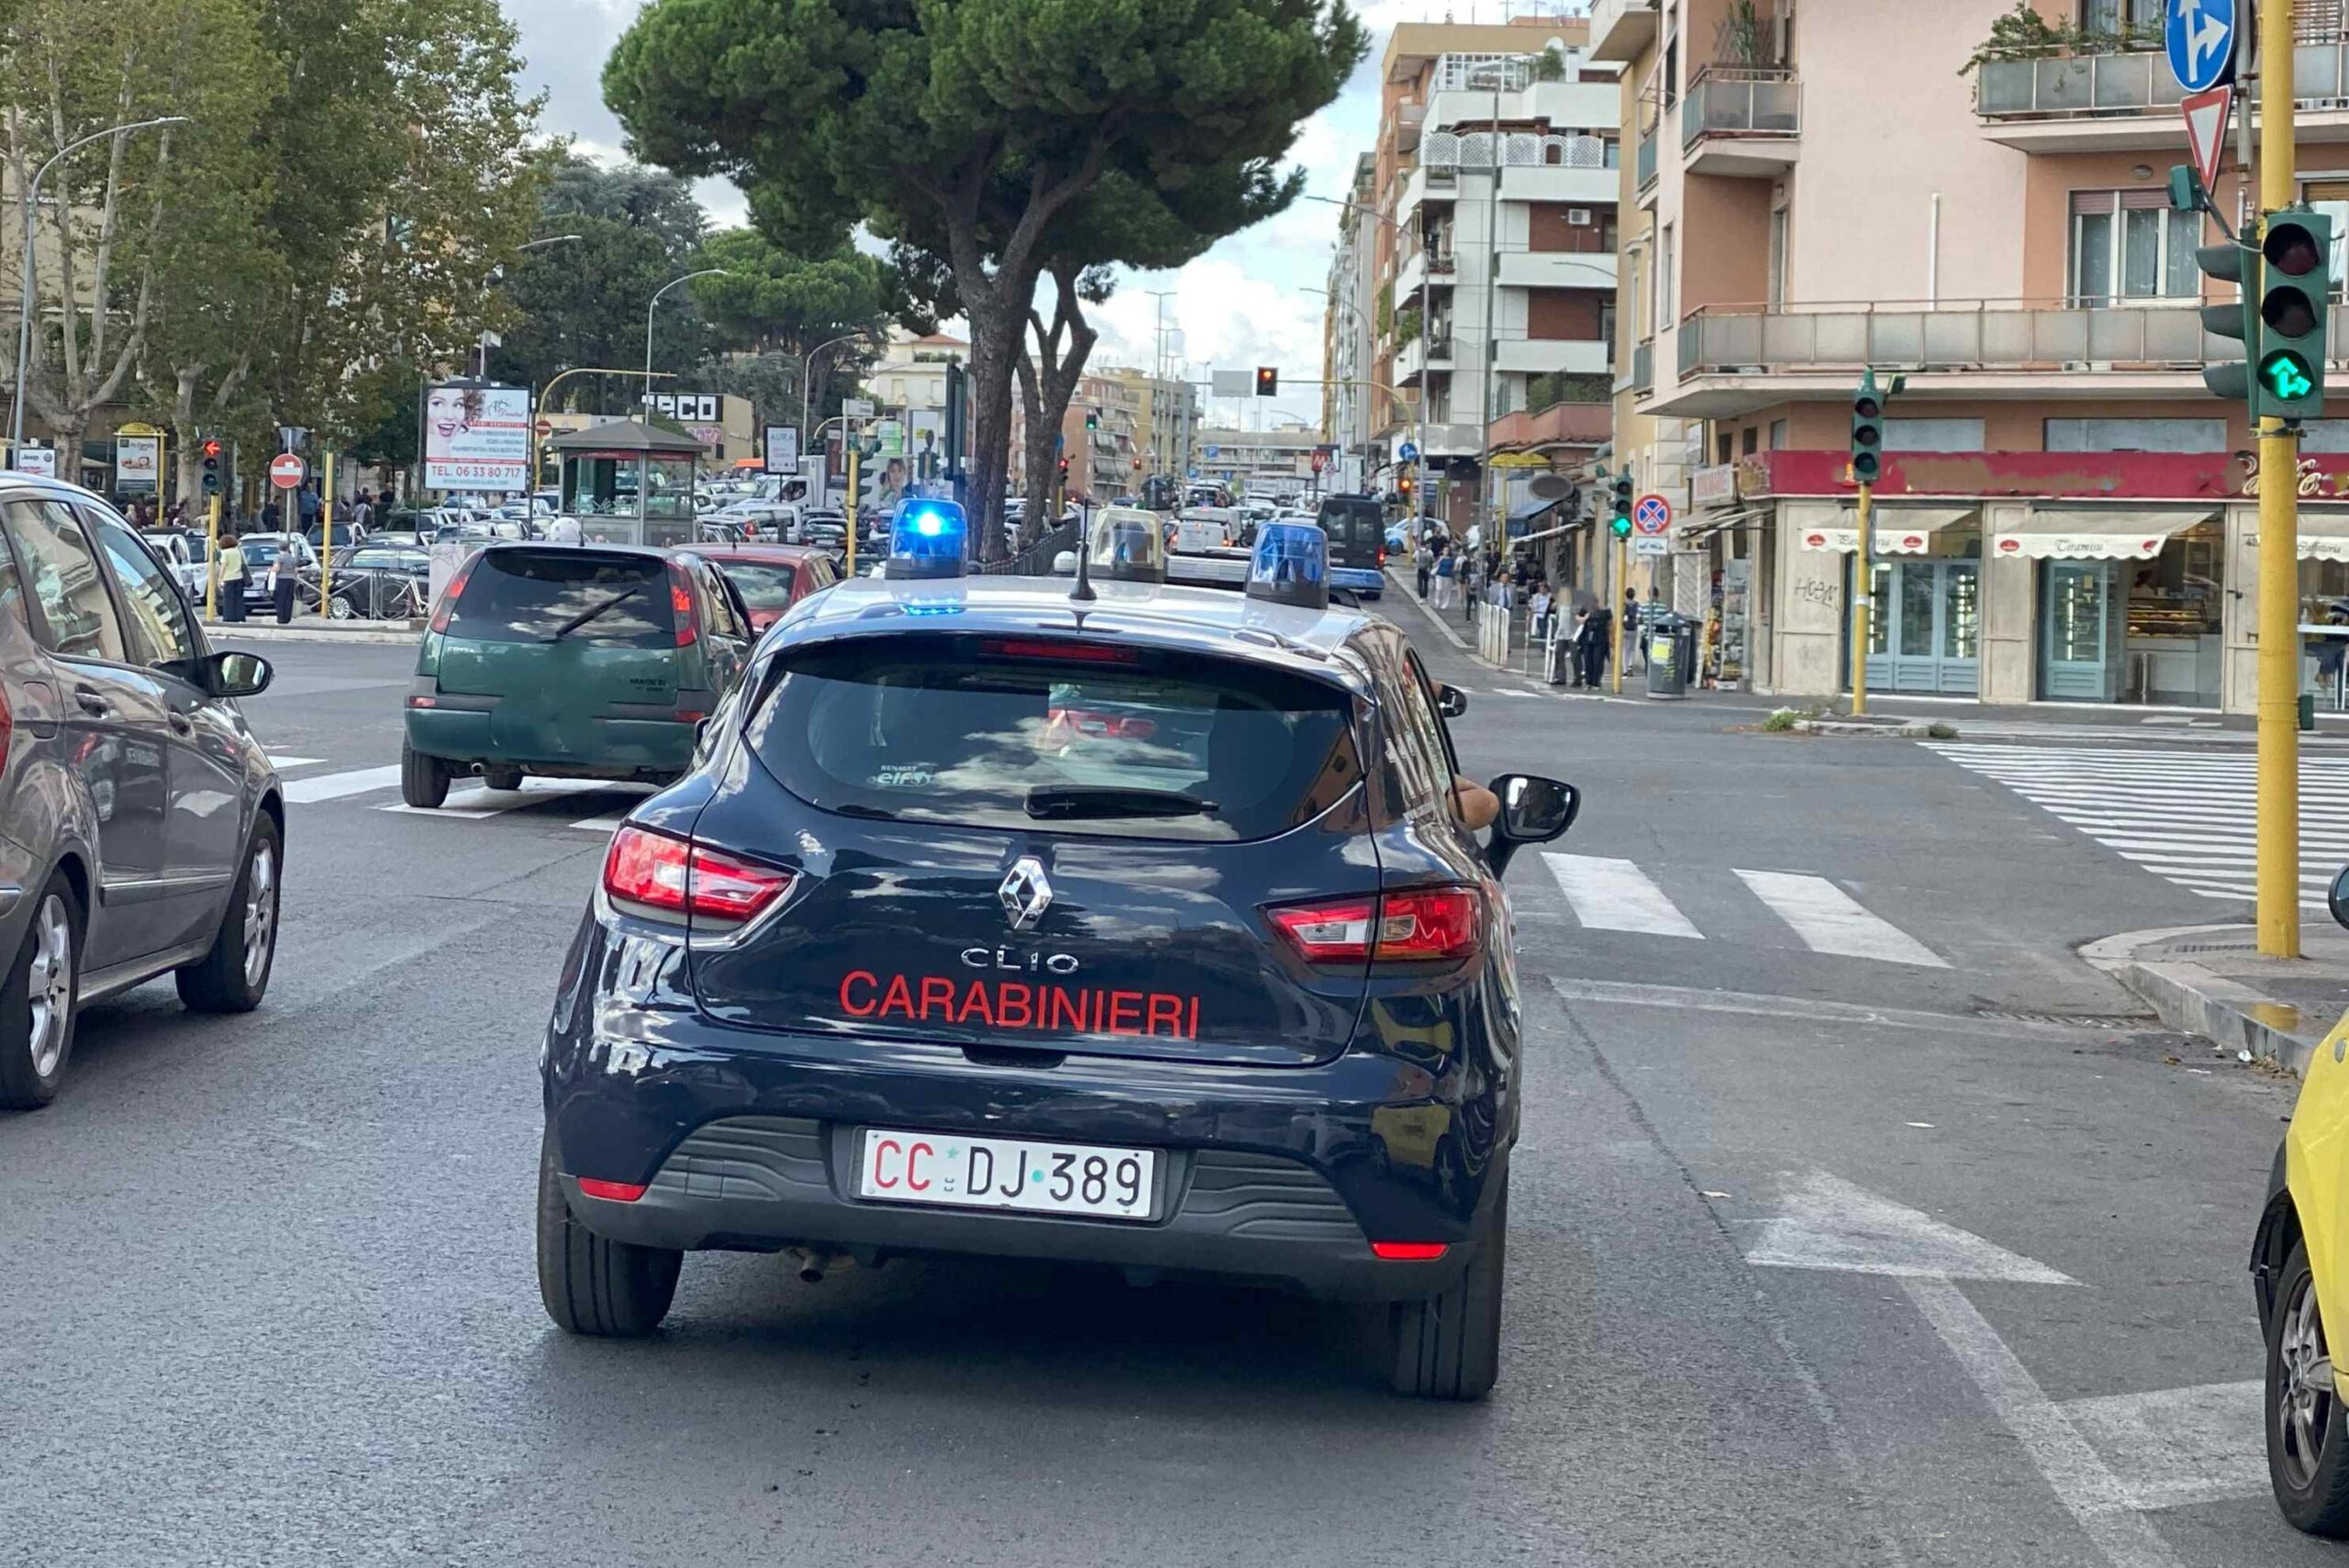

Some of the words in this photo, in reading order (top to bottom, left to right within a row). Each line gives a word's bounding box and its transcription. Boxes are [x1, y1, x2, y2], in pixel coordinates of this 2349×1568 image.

[21, 453, 39, 462] Jeep
[431, 465, 453, 476] TEL.
[456, 466, 470, 477] 06
[473, 467, 485, 477] 33
[487, 467, 501, 477] 80
[504, 467, 521, 478] 717
[877, 772, 912, 784] elf
[961, 947, 1080, 975] CLIO
[839, 970, 1200, 1040] CARABINIERI
[874, 1139, 934, 1191] CC
[966, 1145, 1028, 1198] DJ
[1049, 1151, 1141, 1207] 389
